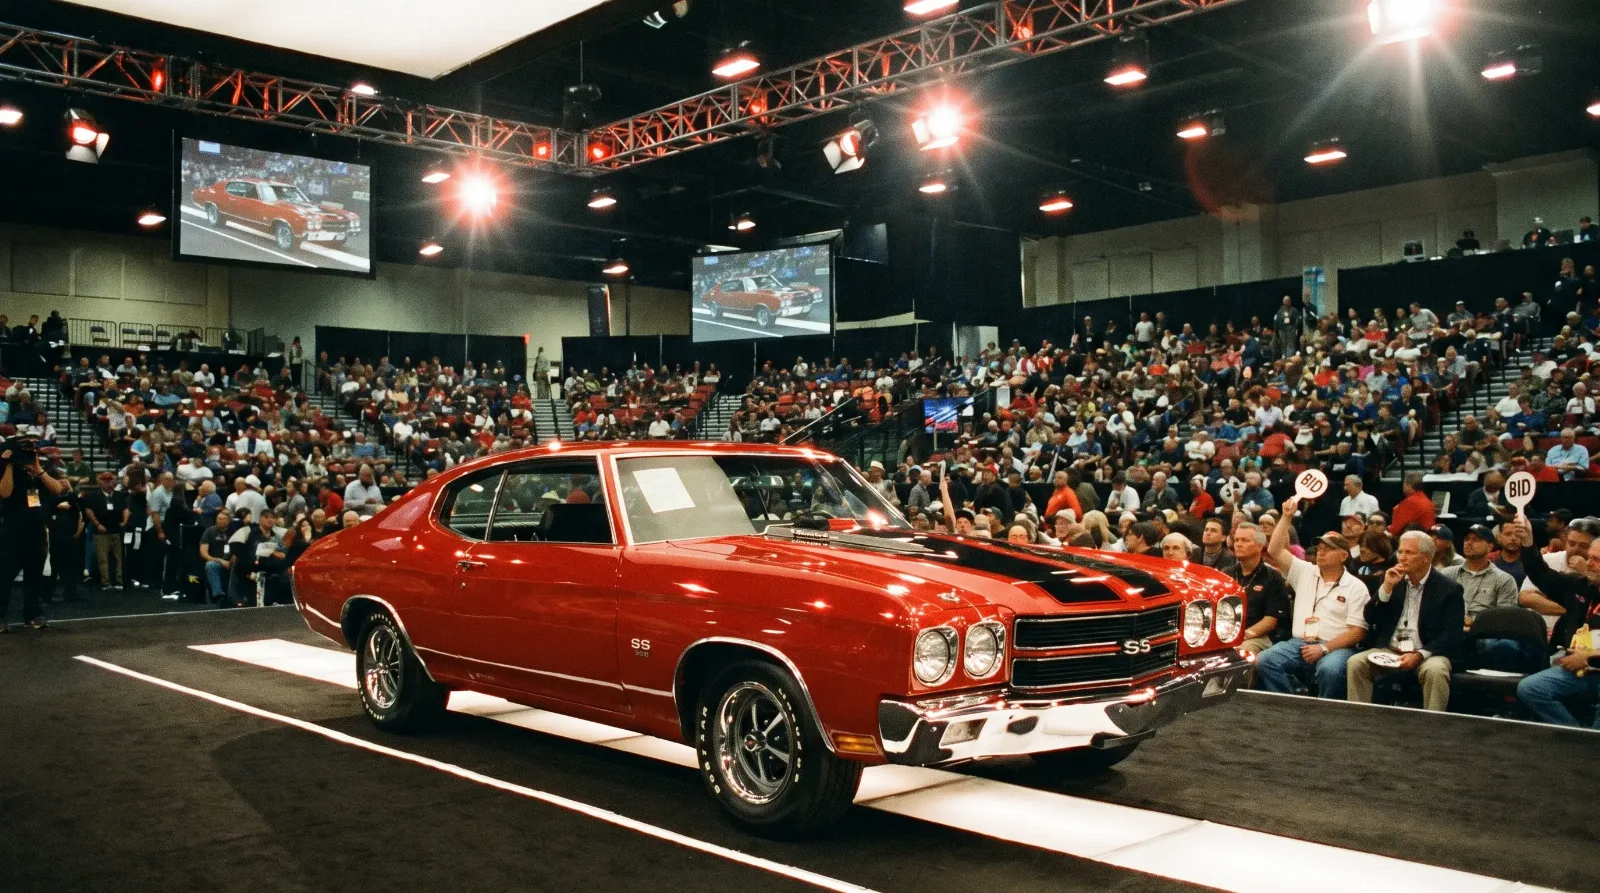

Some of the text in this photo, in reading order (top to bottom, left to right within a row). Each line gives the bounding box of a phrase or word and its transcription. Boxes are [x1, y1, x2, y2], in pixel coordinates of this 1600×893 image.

[1300, 472, 1323, 493] BID
[1509, 478, 1531, 498] BID
[631, 638, 651, 650] SS
[1123, 638, 1151, 655] SS
